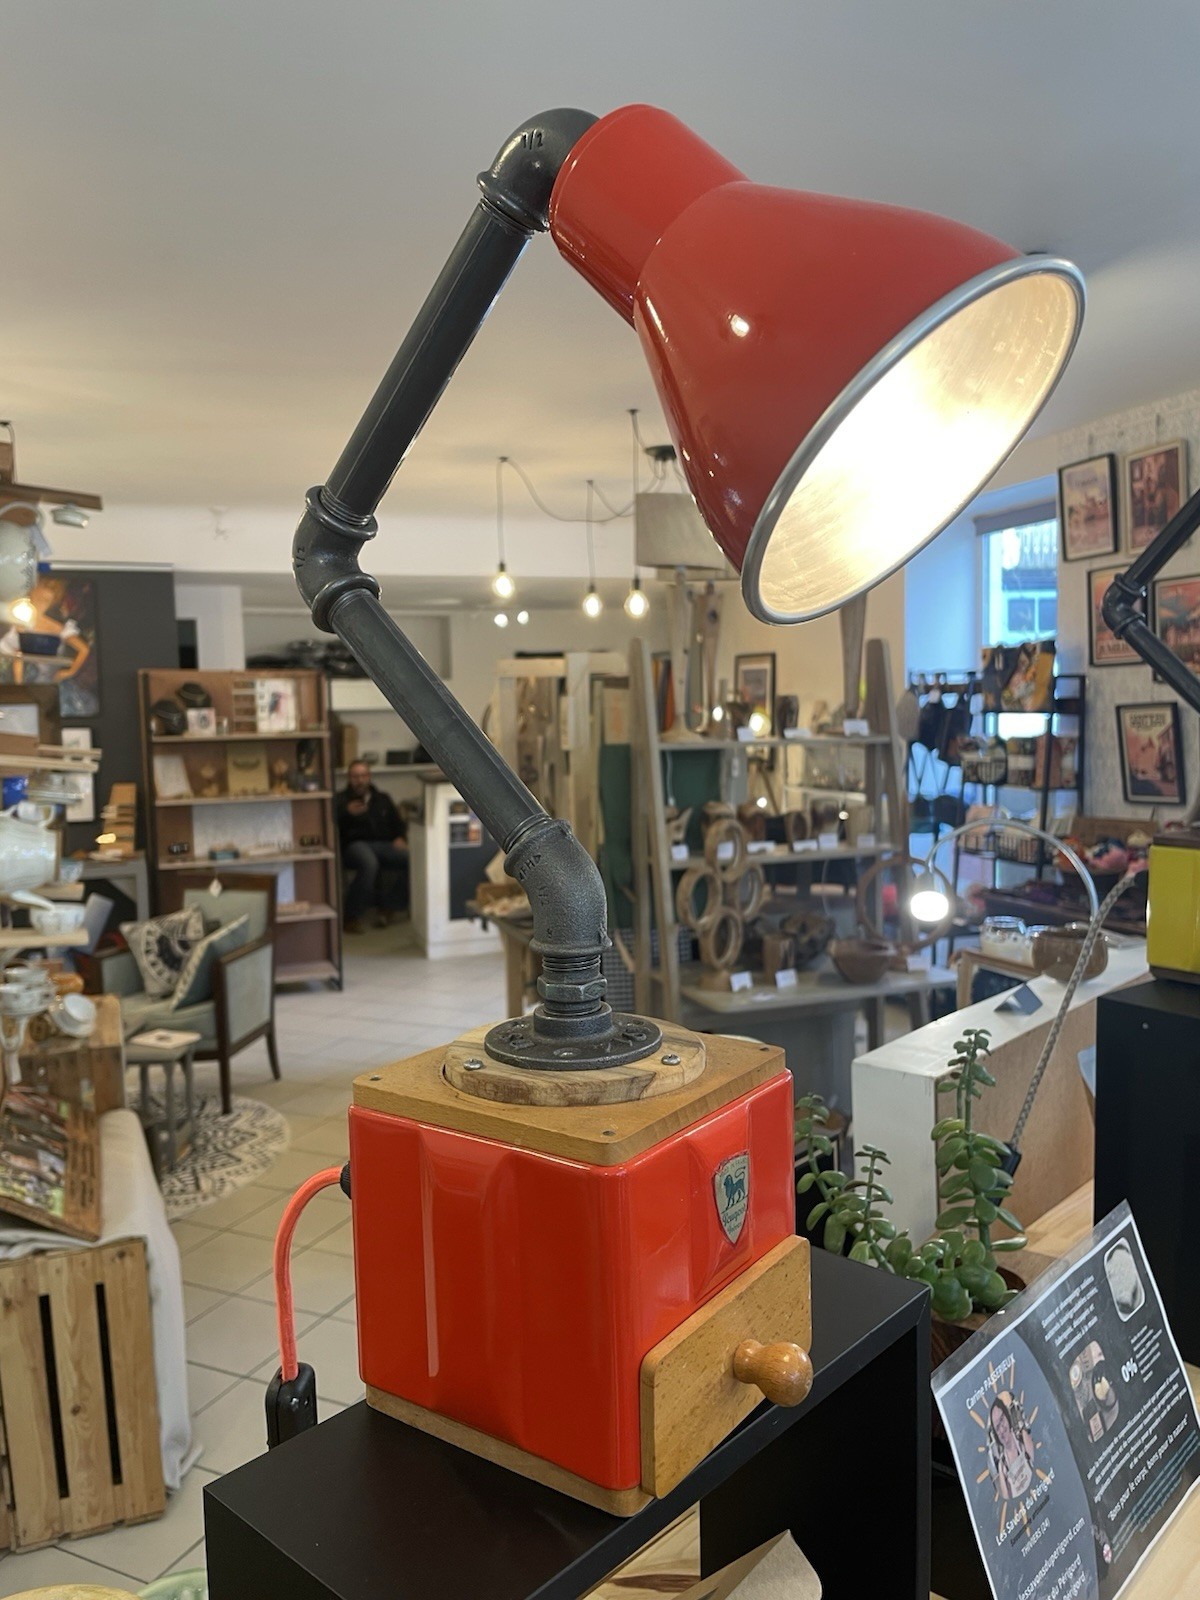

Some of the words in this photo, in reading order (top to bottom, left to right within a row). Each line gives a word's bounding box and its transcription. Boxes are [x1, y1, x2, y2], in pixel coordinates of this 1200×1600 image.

[521, 129, 543, 150] 1/2
[1122, 1357, 1138, 1382] 0%
[966, 1386, 985, 1409] Carine
[1120, 1488, 1130, 1508] pour
[1128, 1483, 1135, 1492] le
[1147, 1453, 1159, 1469] bons
[1158, 1440, 1169, 1458] pour
[1168, 1435, 1174, 1444] la
[995, 1531, 1007, 1546] Les
[1026, 1497, 1034, 1510] du
[1051, 1585, 1060, 1600] du
[1058, 1553, 1082, 1589] Périgord
